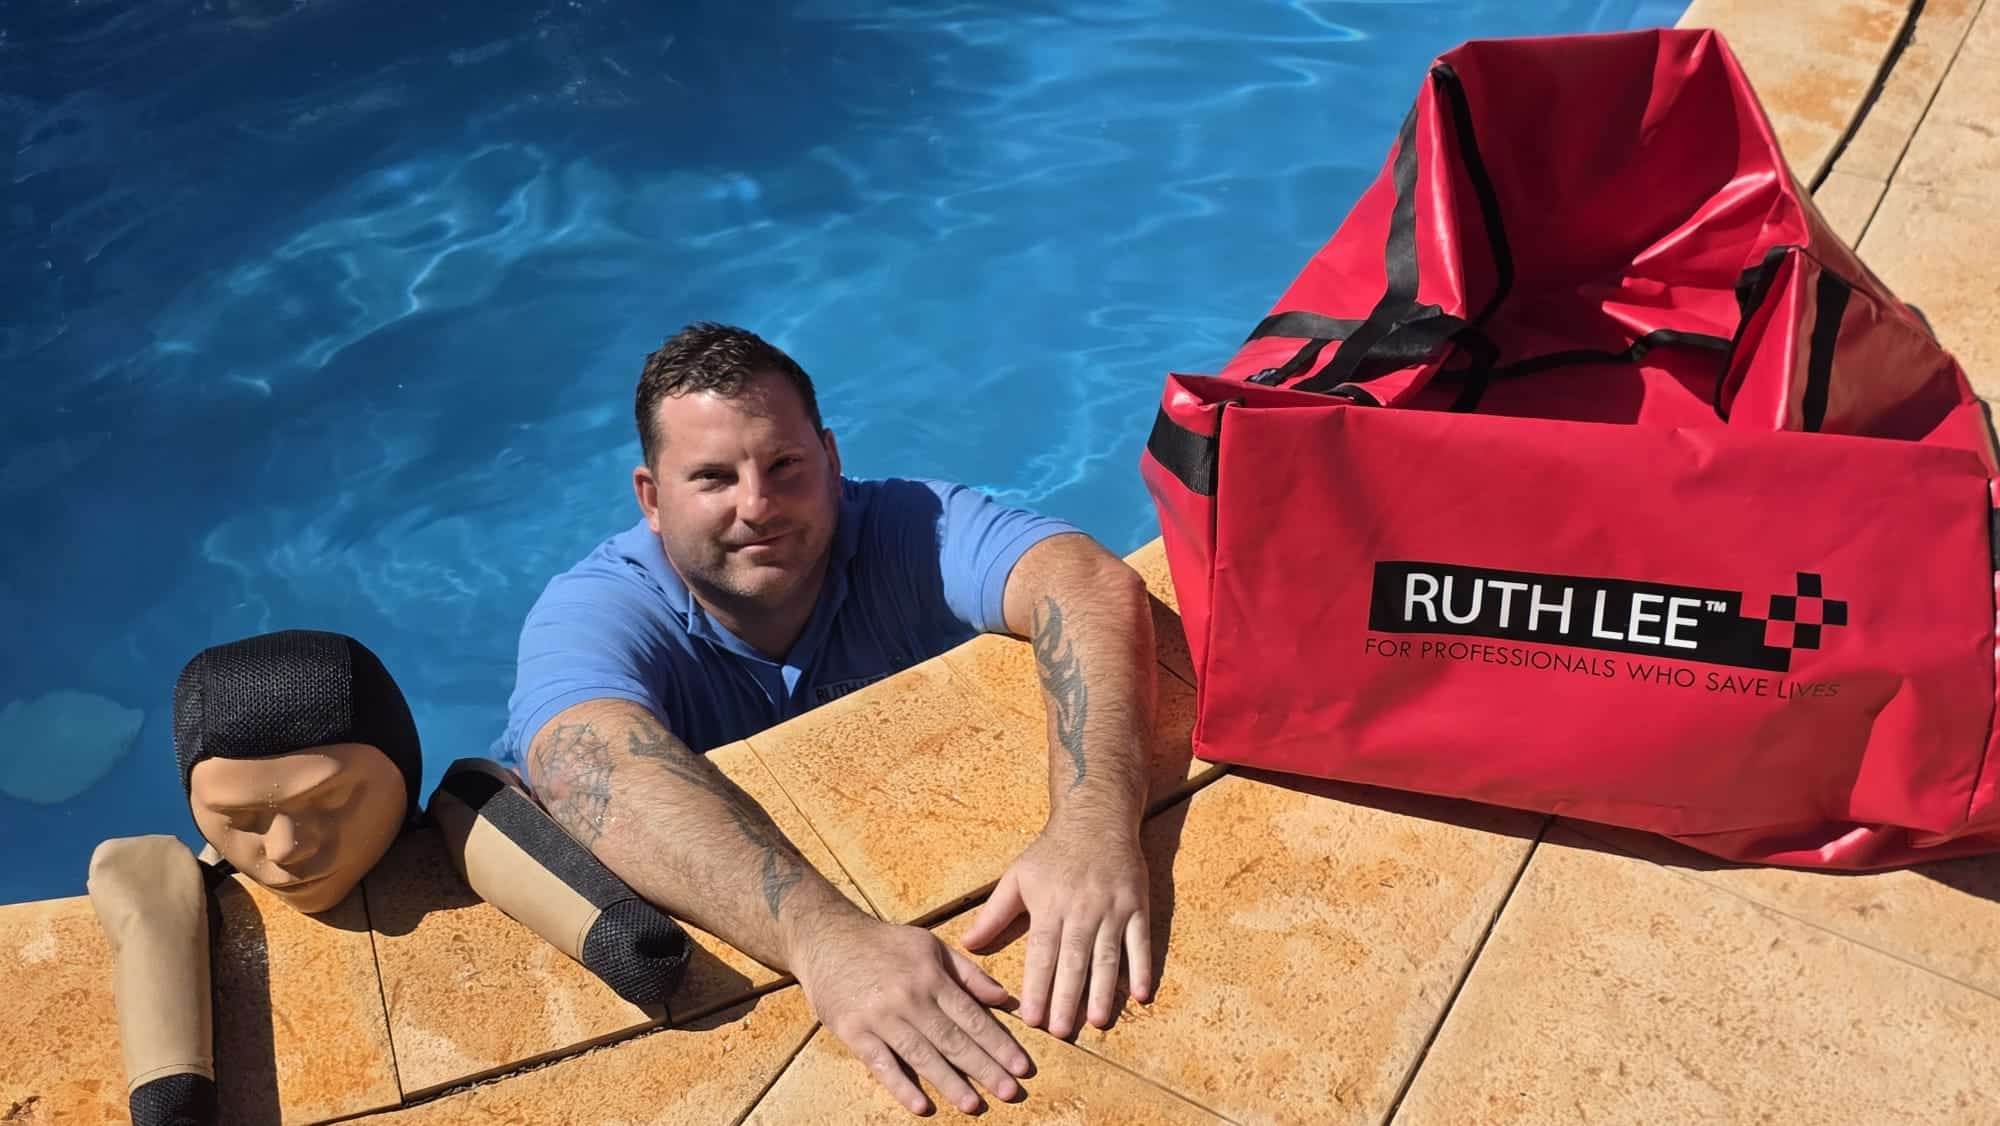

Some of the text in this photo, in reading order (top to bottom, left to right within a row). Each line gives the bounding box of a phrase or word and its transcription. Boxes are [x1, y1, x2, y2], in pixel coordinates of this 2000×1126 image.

[1404, 573, 1574, 634] RUTH
[1366, 638, 1840, 700] FOR PROFESSIONALS WHO SAVE LIVES
